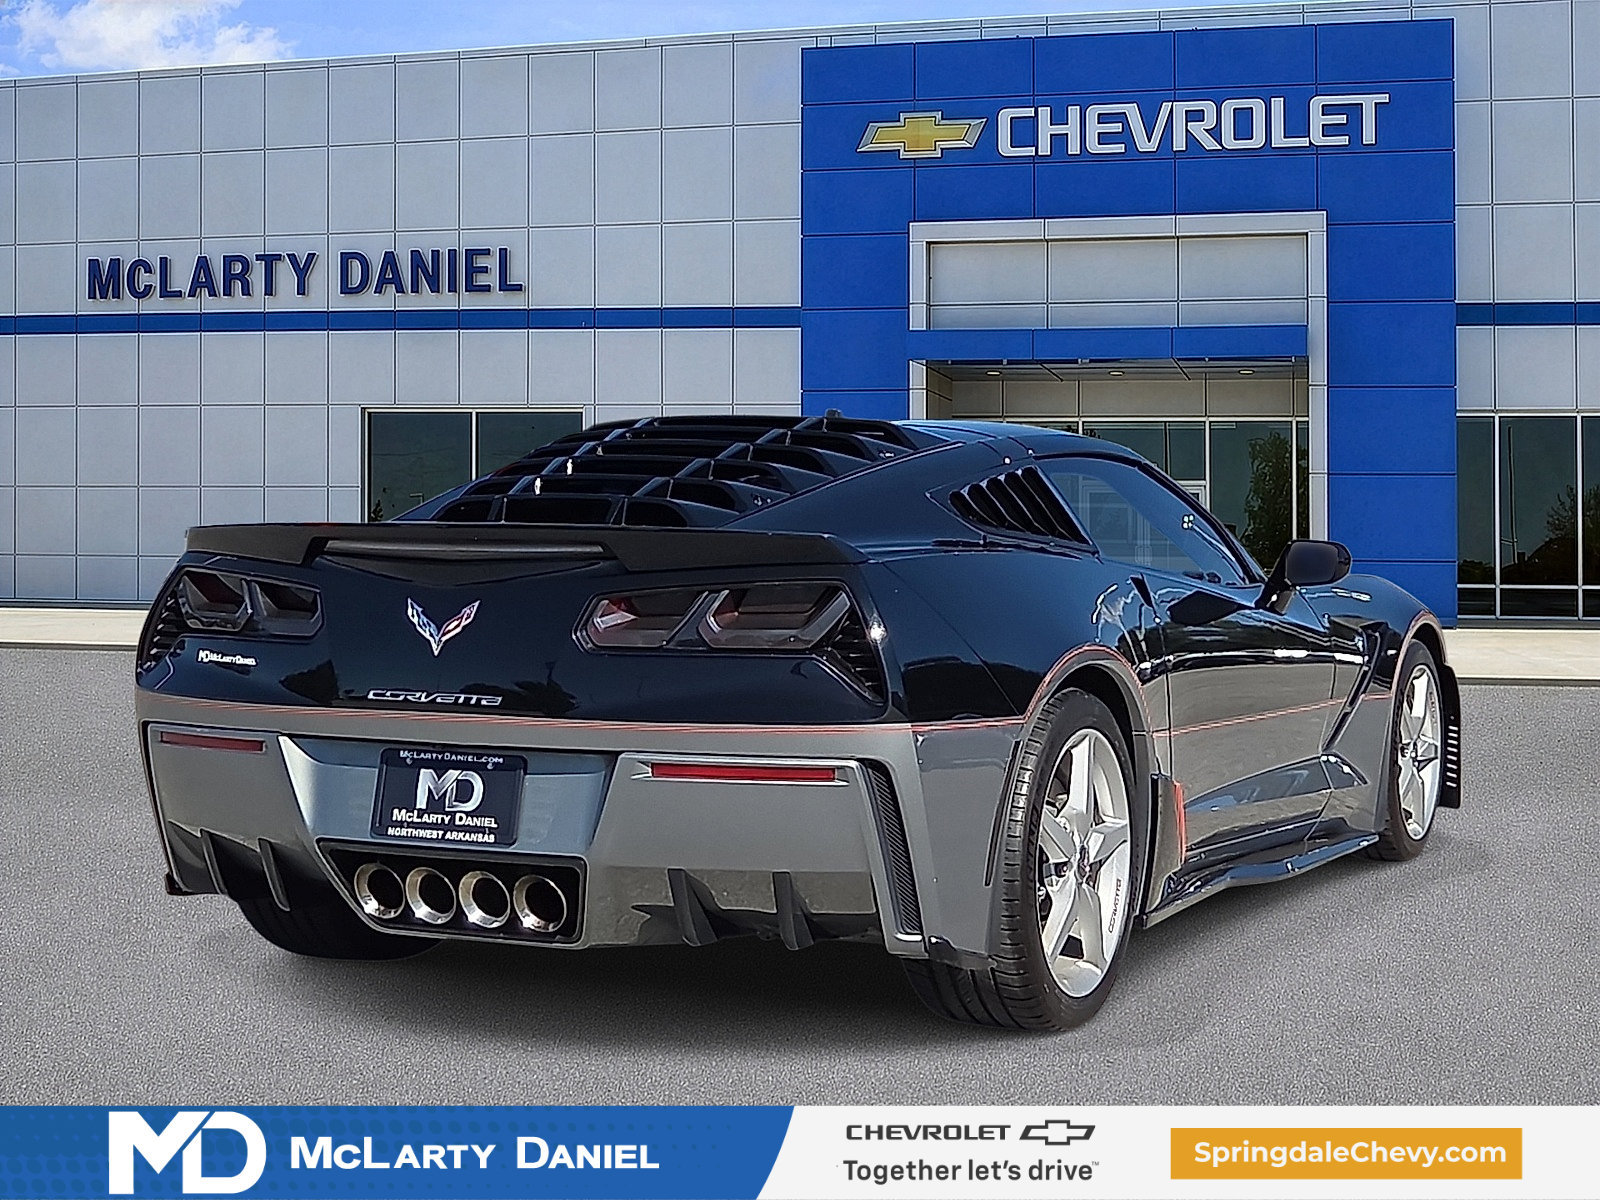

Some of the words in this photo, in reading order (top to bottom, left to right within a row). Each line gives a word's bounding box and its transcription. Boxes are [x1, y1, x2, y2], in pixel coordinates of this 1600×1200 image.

[997, 93, 1390, 157] CHEVROLET
[339, 247, 524, 296] DANIEL
[367, 690, 503, 705] CORVETTE
[416, 768, 484, 812] MD
[387, 826, 443, 840] NORTHWEST
[445, 831, 495, 843] ARKANSAS
[455, 813, 498, 828] DANIEL
